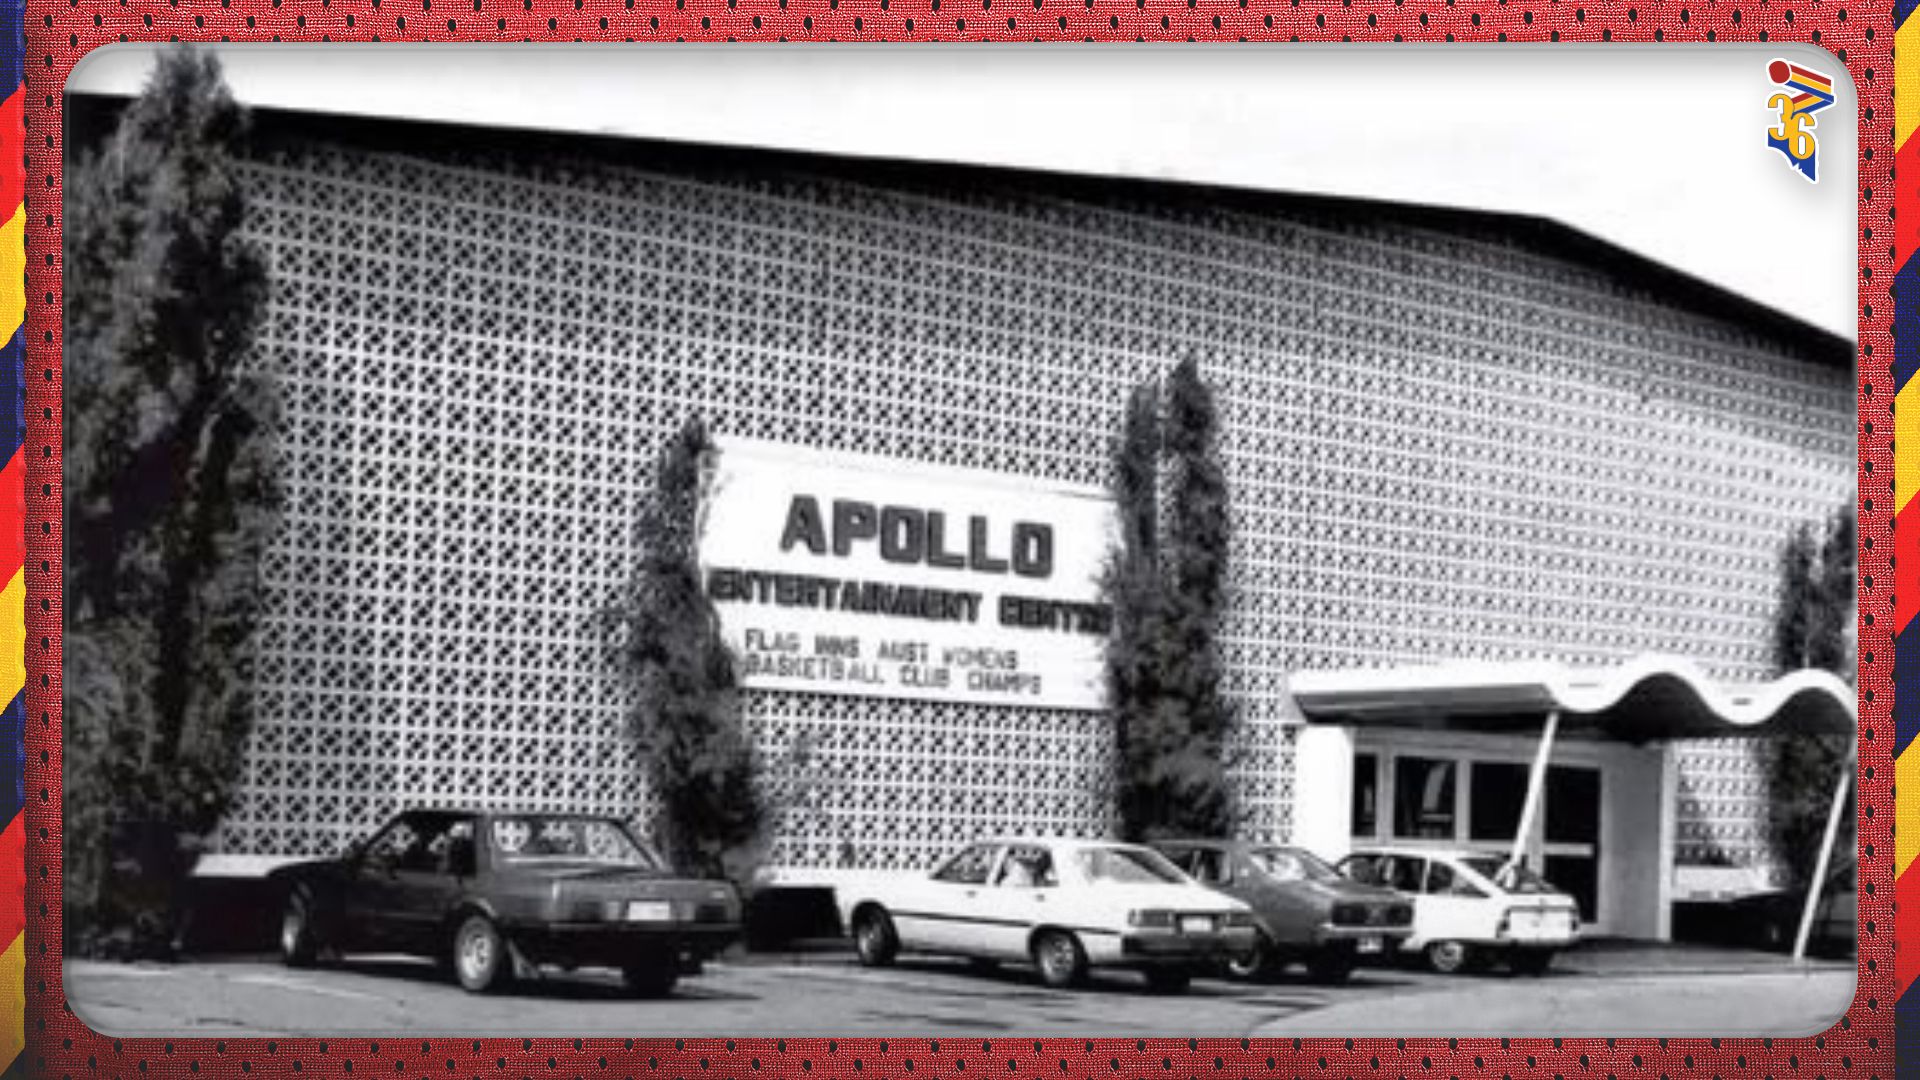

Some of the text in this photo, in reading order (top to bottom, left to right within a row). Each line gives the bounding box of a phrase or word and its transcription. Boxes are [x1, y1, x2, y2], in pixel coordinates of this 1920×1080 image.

[779, 494, 1053, 579] APOLLO
[708, 567, 983, 624] ENTERTAINMENT
[745, 628, 801, 654] FLAG
[744, 652, 1042, 695] BASKETBALL CLUB CHAMPS
